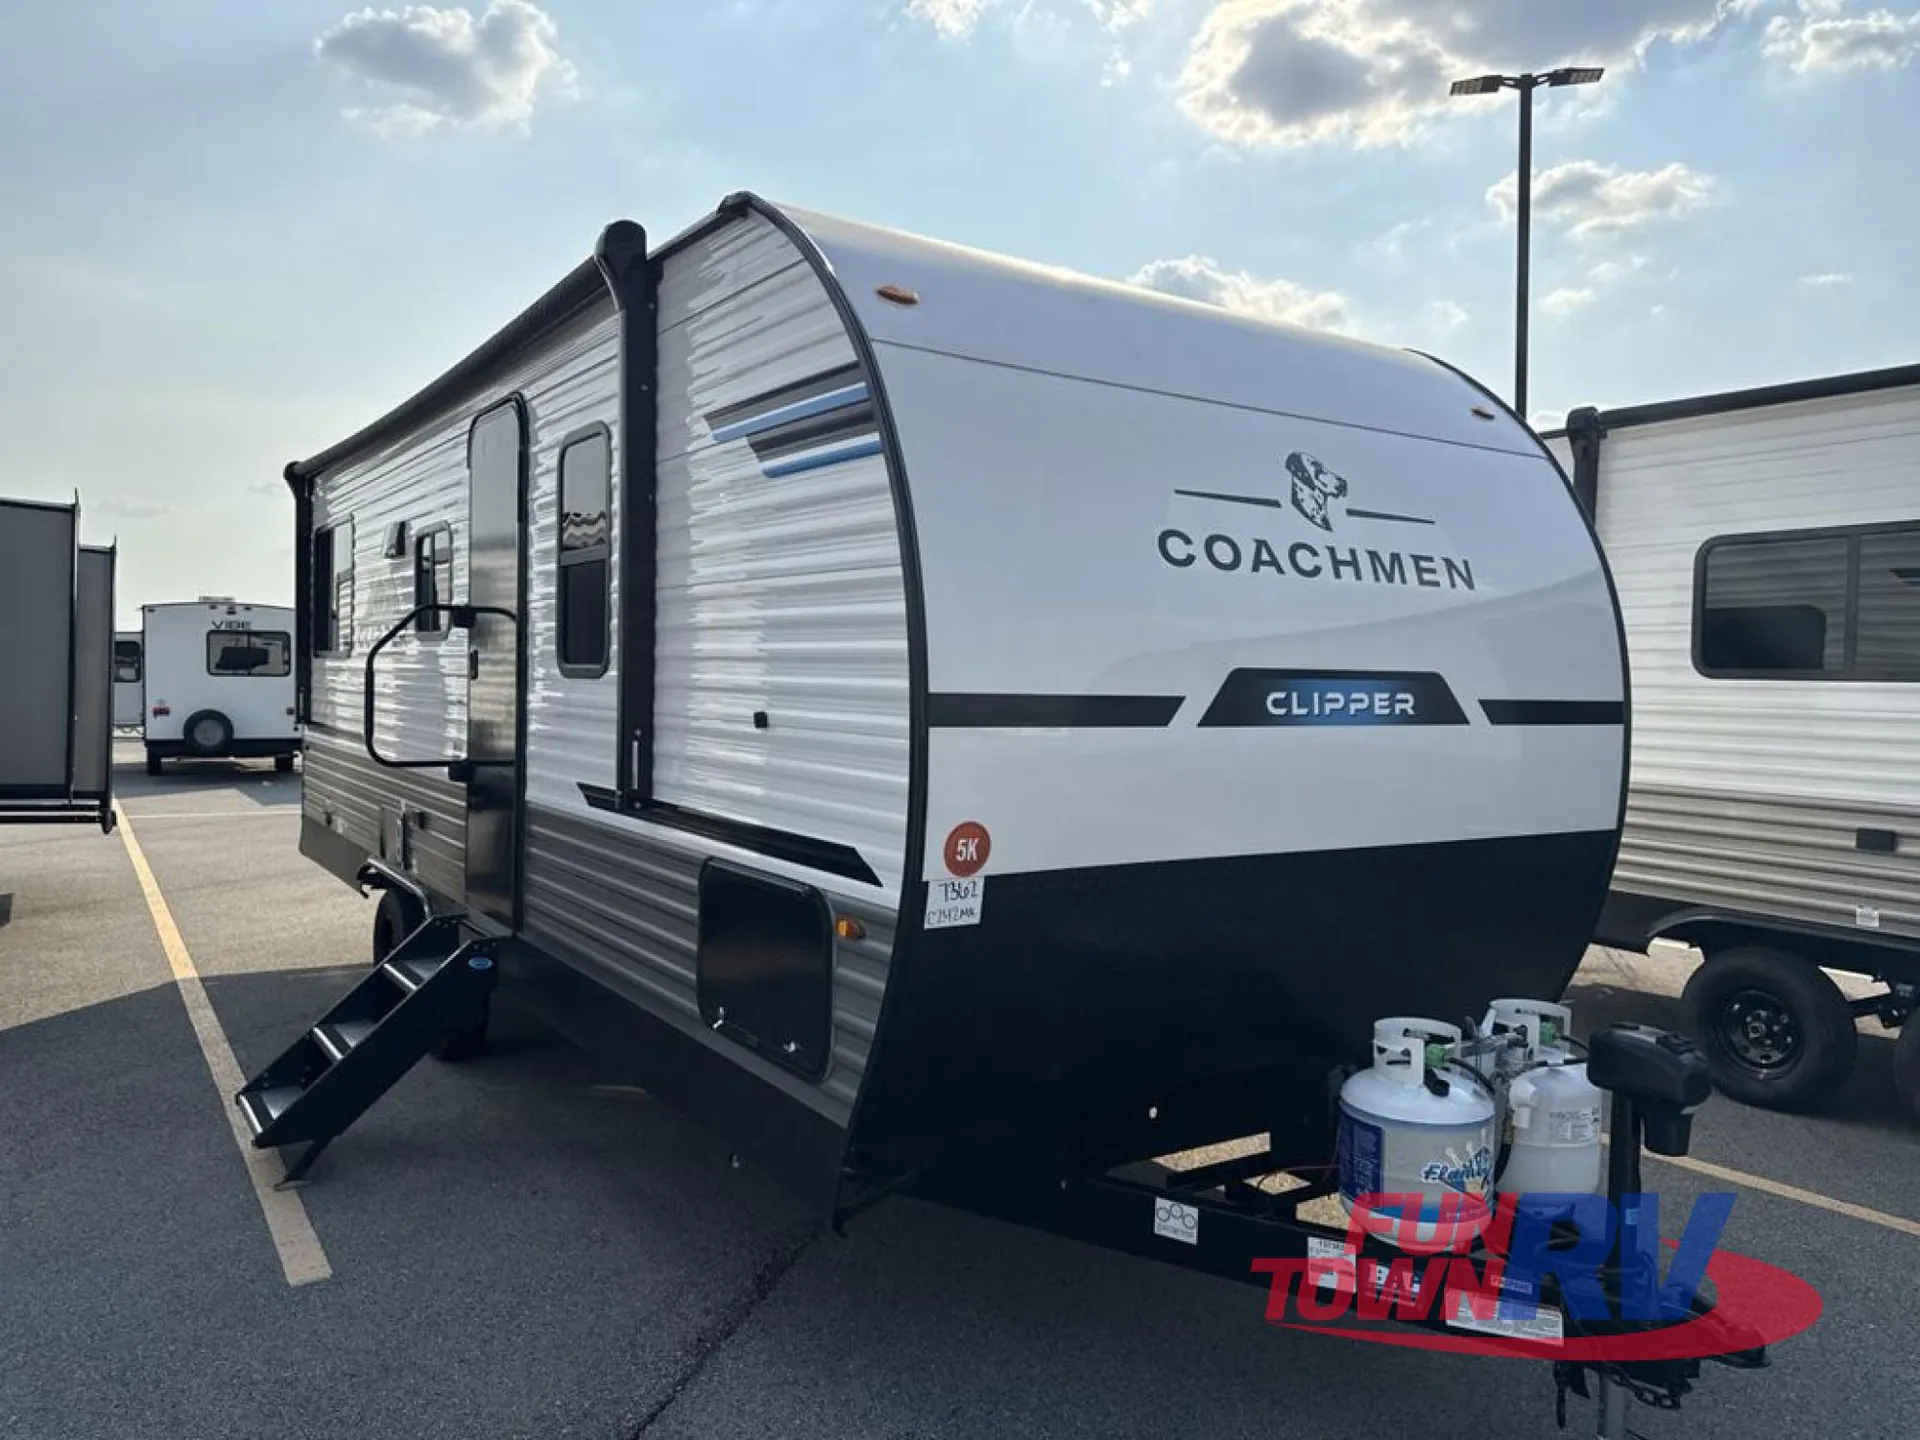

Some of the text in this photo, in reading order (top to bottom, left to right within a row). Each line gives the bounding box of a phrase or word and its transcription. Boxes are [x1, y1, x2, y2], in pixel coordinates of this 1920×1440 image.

[1158, 528, 1476, 591] COACHMEN
[1266, 691, 1416, 716] CLIPPER
[955, 837, 979, 861] 5K
